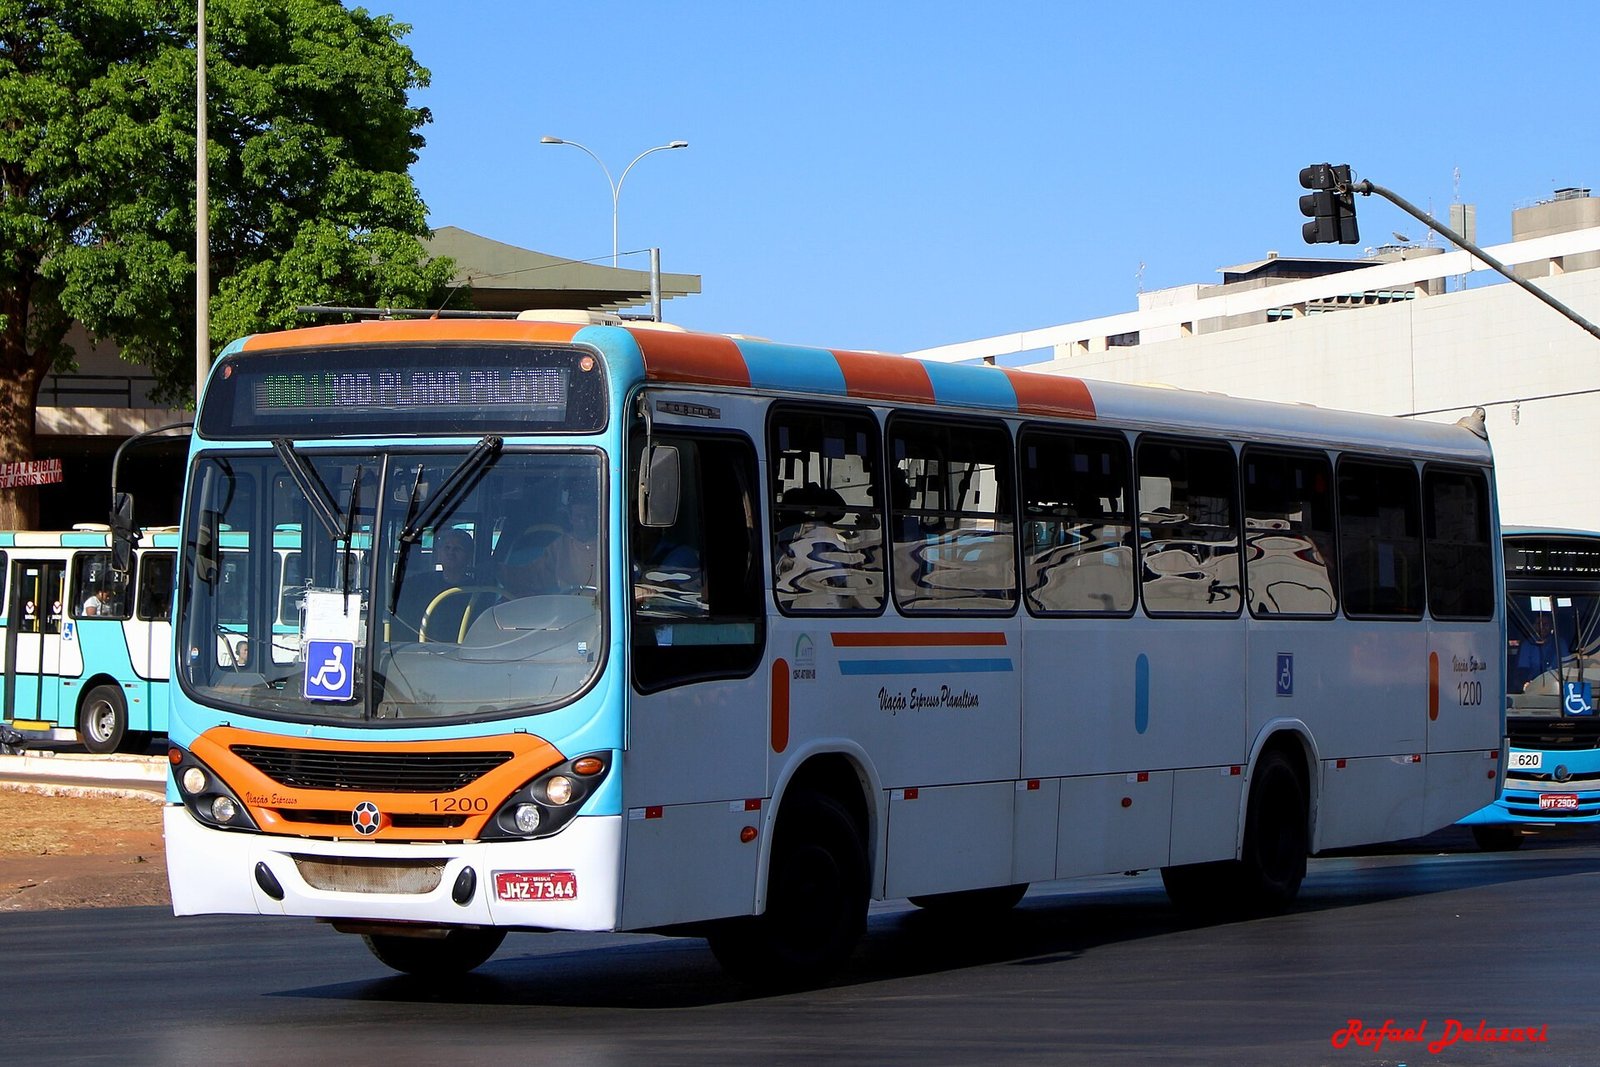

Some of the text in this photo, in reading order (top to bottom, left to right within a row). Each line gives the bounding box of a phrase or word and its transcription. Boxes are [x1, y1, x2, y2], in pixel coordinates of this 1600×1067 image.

[470, 369, 560, 403] PILOTO
[24, 461, 29, 474] A
[10, 474, 37, 487] JESUS
[39, 471, 63, 484] SALVA
[878, 684, 979, 716] Viação Expresso Planaltina
[1457, 681, 1482, 706] 1200
[429, 797, 488, 812] 1200
